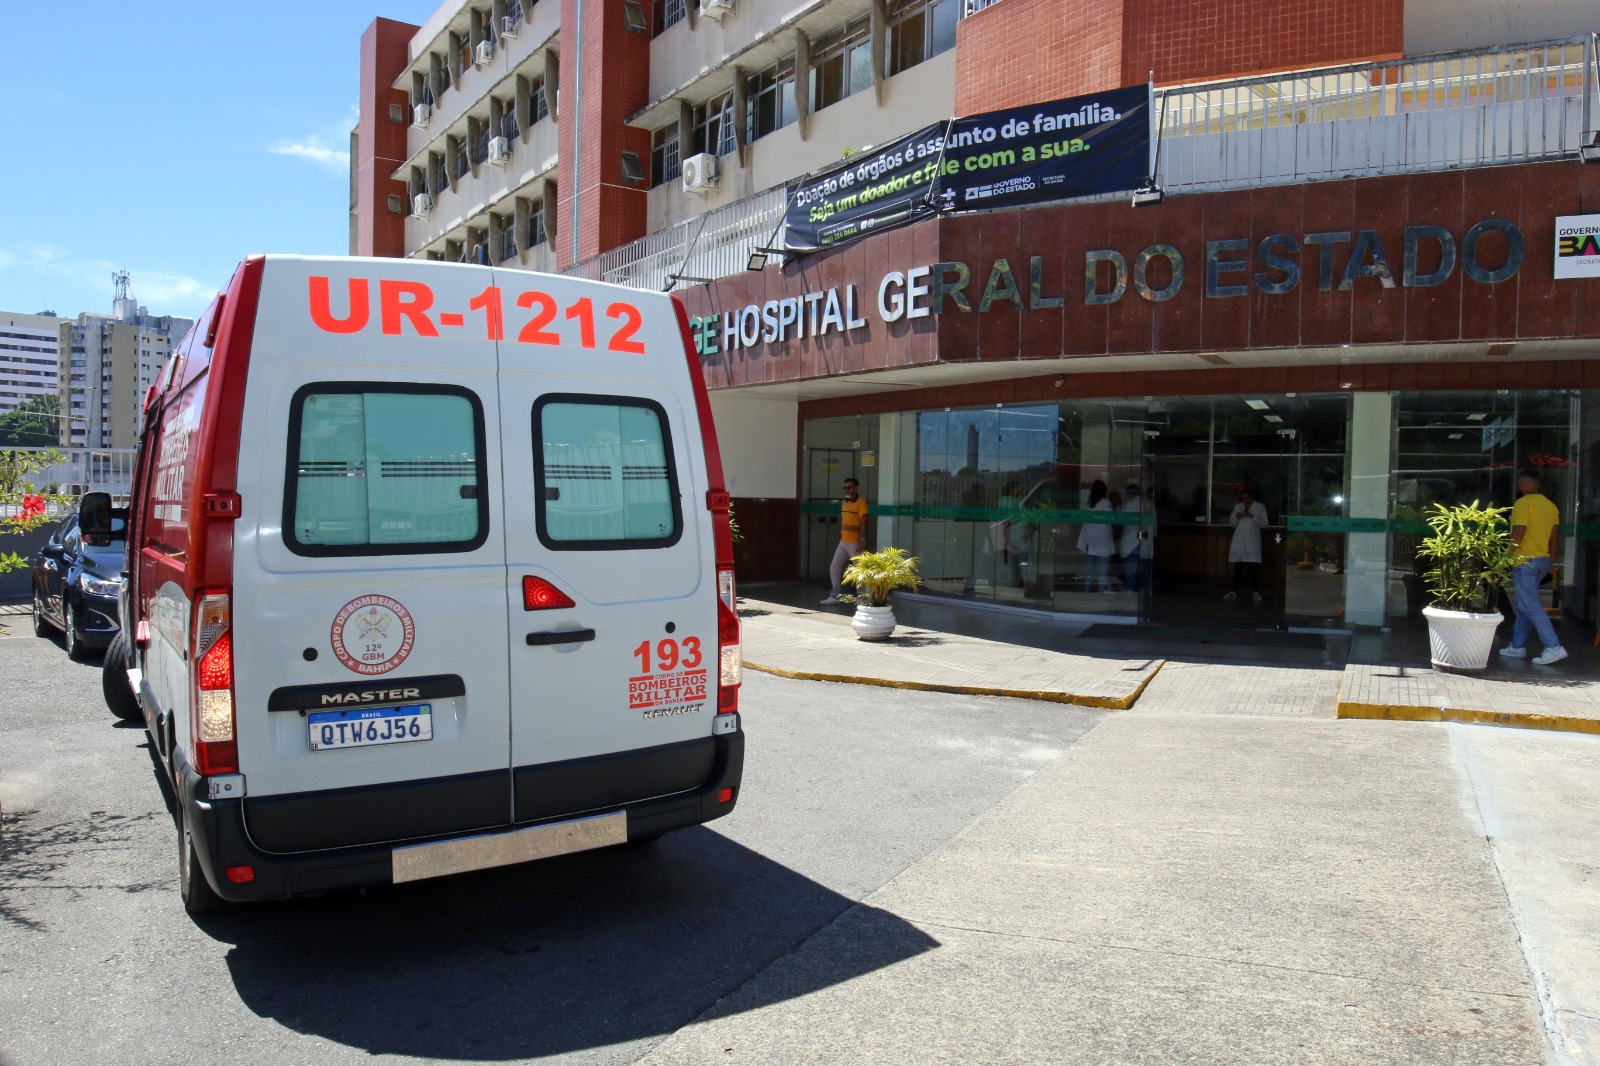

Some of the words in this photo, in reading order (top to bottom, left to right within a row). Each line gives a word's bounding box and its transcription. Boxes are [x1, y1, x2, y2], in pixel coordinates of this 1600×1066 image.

[797, 178, 837, 207] Doação
[839, 171, 855, 188] de
[856, 153, 902, 181] órgãos
[905, 143, 915, 162] é
[917, 126, 997, 158] assunto
[1001, 118, 1030, 139] de
[1033, 102, 1122, 134] família.
[809, 200, 834, 223] Seja
[836, 194, 857, 213] um
[860, 174, 910, 203] doador
[912, 170, 922, 185] e
[923, 157, 960, 182] fale
[964, 150, 1016, 171] com
[1022, 146, 1036, 162] a
[1041, 138, 1091, 159] sua.
[993, 176, 1031, 188] GOVERNO
[993, 188, 1005, 196] DO
[1005, 182, 1035, 193] ESTADO
[1560, 227, 1600, 235] GOVERN
[723, 284, 866, 351] HOSPITAL
[878, 256, 1066, 323] GERAL
[1085, 243, 1184, 305] DO
[1205, 218, 1525, 298] ESTADO
[308, 276, 646, 354] UR-1212
[155, 464, 185, 502] MILITAR
[347, 596, 406, 616] BOMBEIROS
[337, 611, 348, 625] DE
[333, 626, 348, 660] CORPO
[399, 616, 413, 657] MILITAR
[633, 636, 702, 674] 193
[358, 662, 393, 673] BAHIA
[655, 672, 675, 680] CORPO
[629, 674, 707, 693] BOMBEIROS
[321, 687, 420, 705] MASTER
[629, 684, 707, 704] MILITAR
[643, 703, 704, 720] RENAULT
[321, 717, 421, 746] QTW6J56
